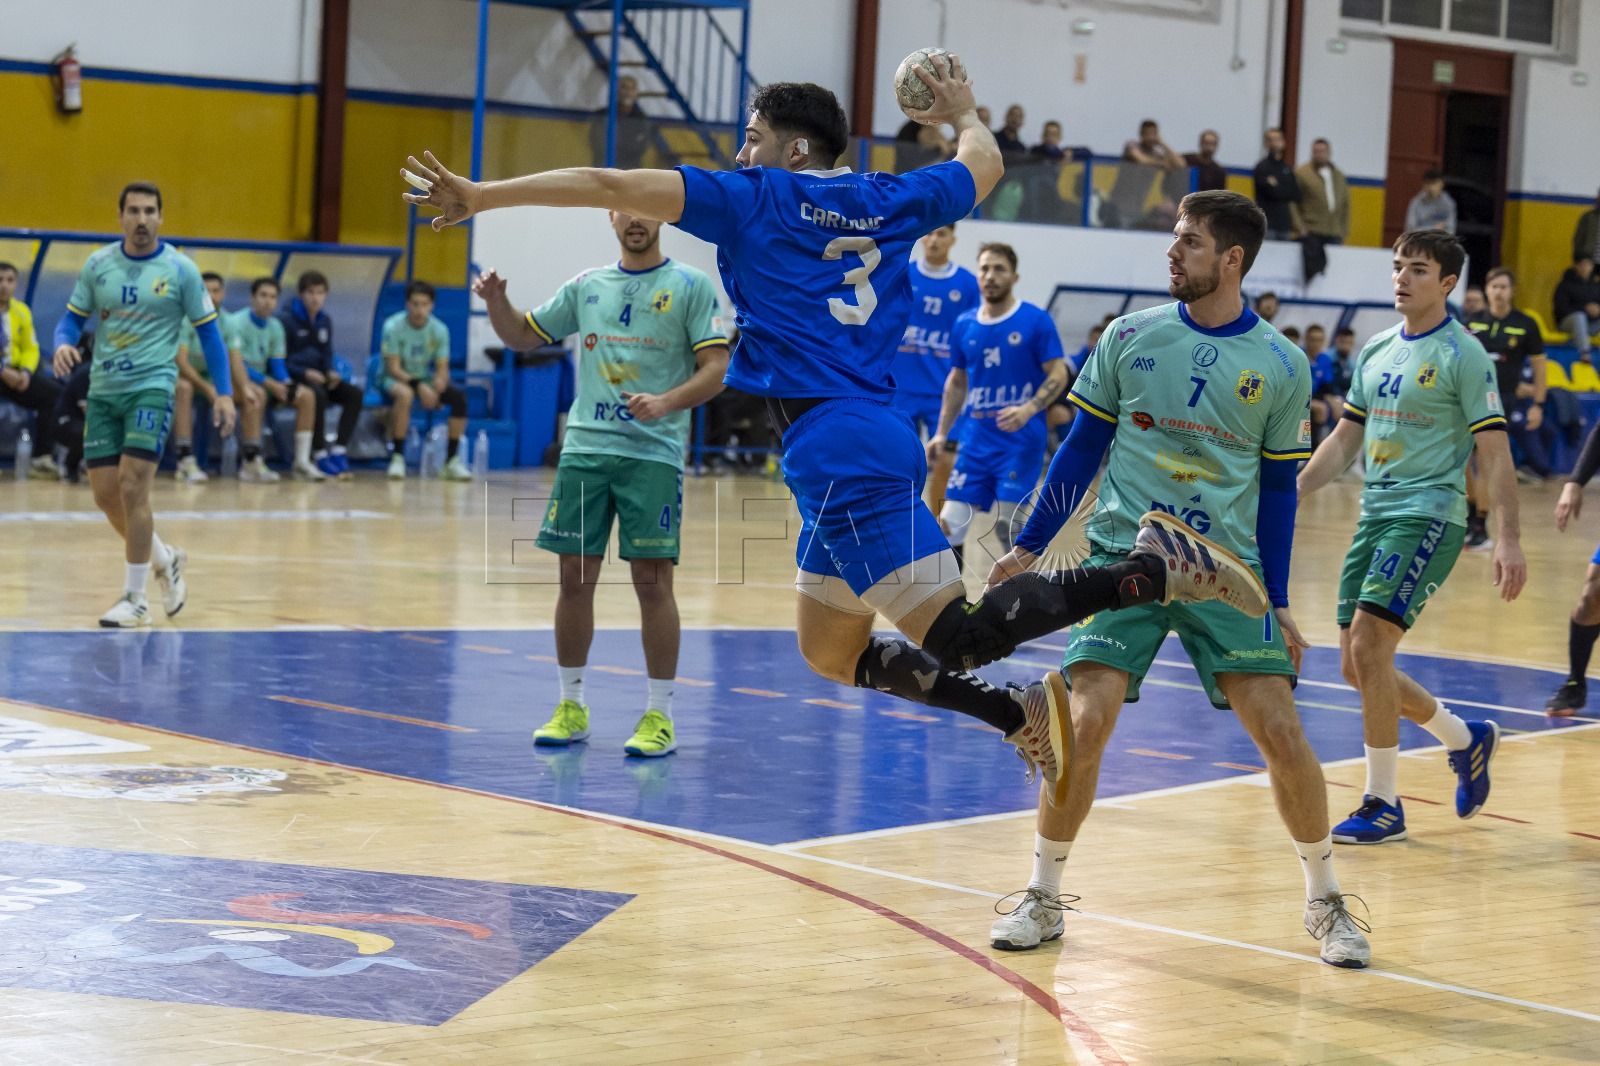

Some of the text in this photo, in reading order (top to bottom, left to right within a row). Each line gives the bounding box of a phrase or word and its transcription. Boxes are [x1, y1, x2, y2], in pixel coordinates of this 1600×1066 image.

[822, 236, 882, 325] 3
[122, 286, 138, 305] 15
[923, 295, 942, 315] 73
[618, 303, 632, 327] 4
[983, 346, 1001, 369] 24
[1187, 375, 1208, 408] 7
[1378, 372, 1404, 399] 24
[136, 409, 156, 432] 15
[658, 503, 671, 535] 4
[1408, 555, 1427, 580] LA
[1115, 640, 1127, 650] TV
